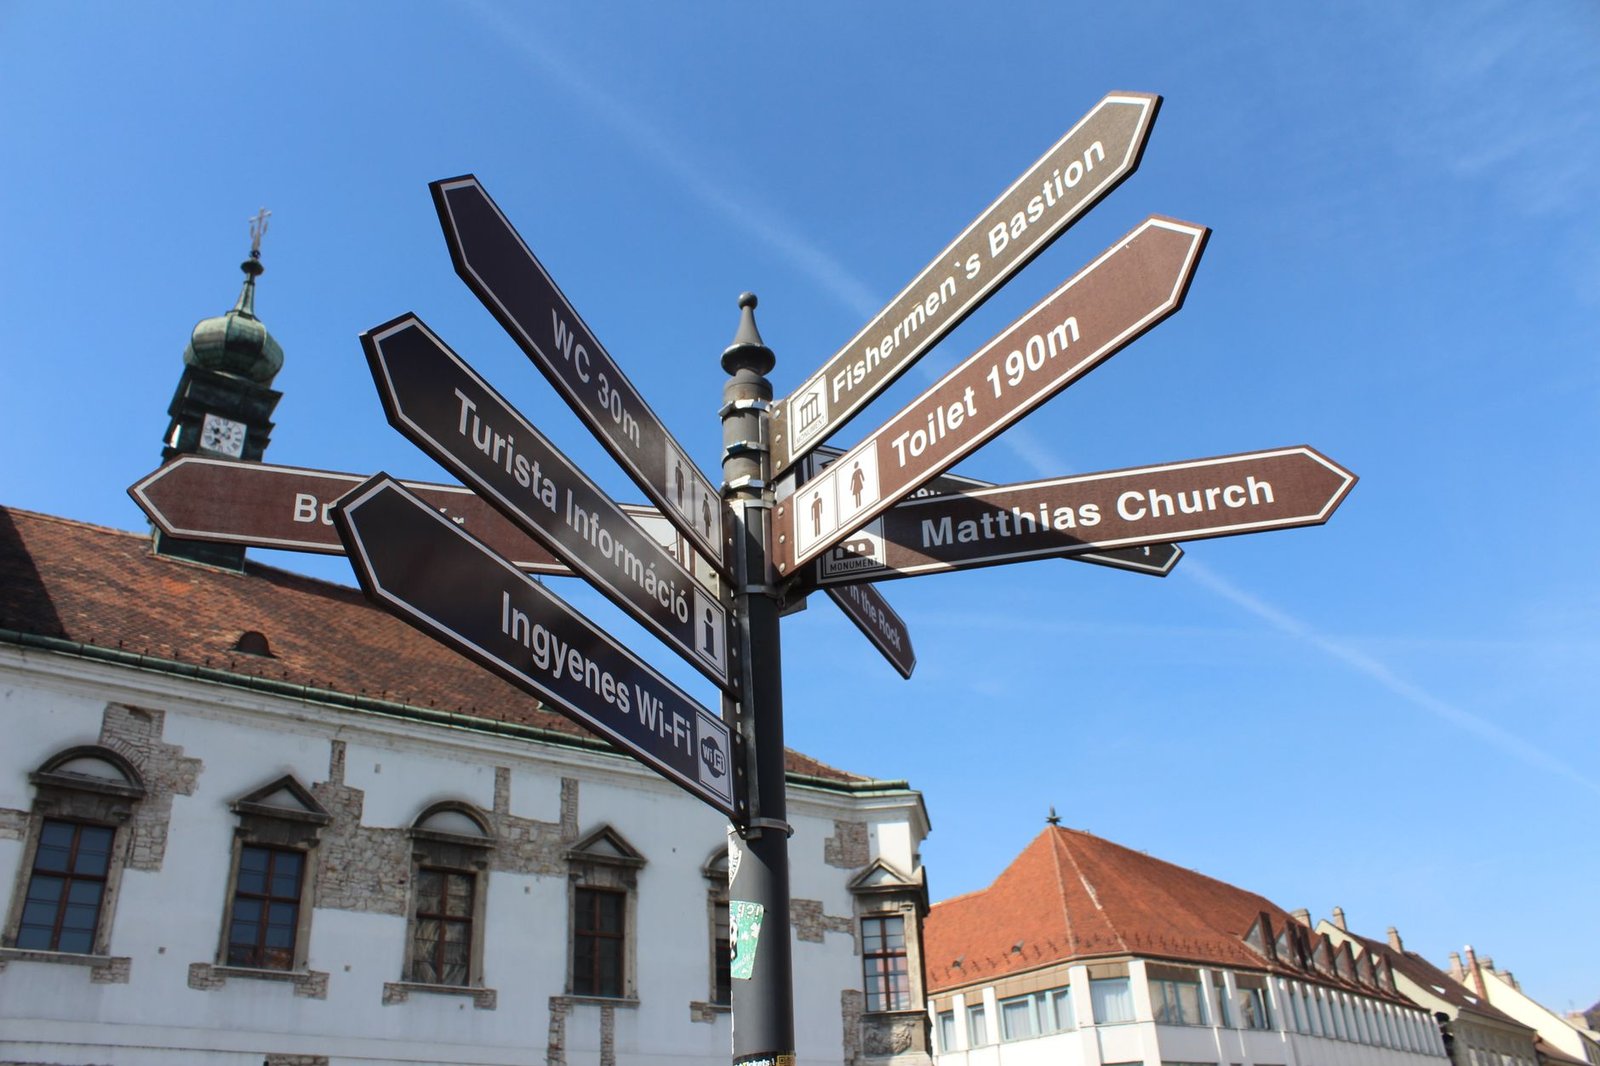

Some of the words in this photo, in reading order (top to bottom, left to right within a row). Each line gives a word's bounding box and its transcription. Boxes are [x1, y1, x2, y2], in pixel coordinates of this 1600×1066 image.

[987, 140, 1106, 259] Bastion
[551, 308, 591, 384] WC
[597, 372, 641, 449] 30m
[891, 389, 977, 468] Toilet
[986, 316, 1080, 399] 190m
[454, 388, 558, 514] Turista
[565, 488, 689, 625] Információ
[829, 558, 878, 571] MONUMENT
[921, 502, 1101, 549] Matthias
[1116, 475, 1275, 522] Church
[501, 590, 631, 714] Ingyenes
[634, 684, 692, 757] Wi-Fi
[861, 591, 878, 623] the
[878, 608, 902, 652] Rock
